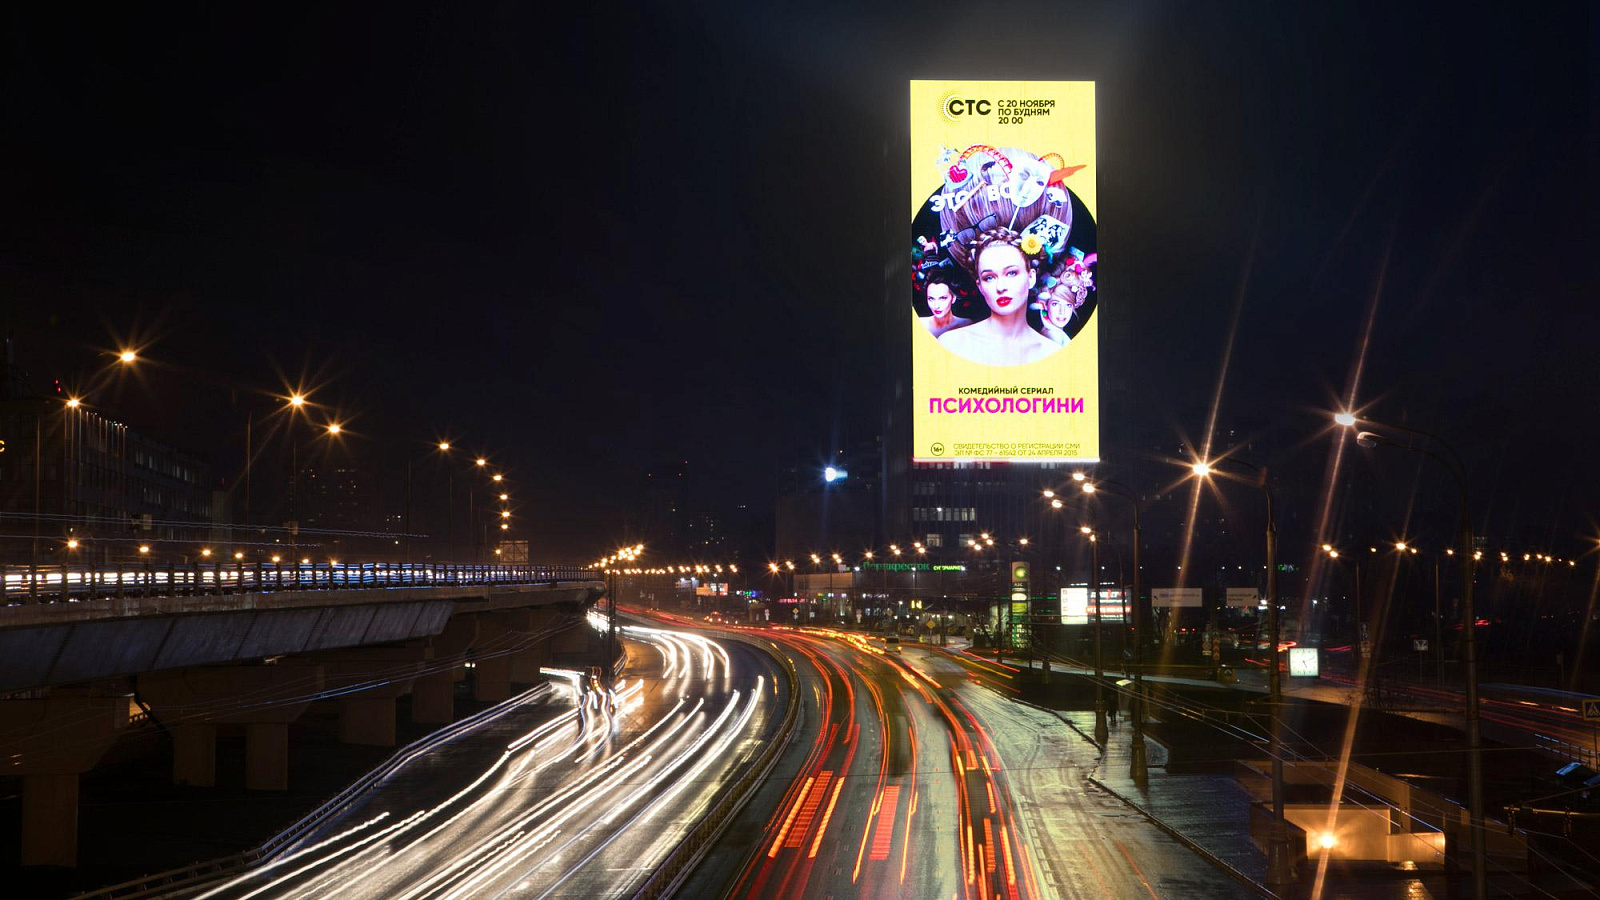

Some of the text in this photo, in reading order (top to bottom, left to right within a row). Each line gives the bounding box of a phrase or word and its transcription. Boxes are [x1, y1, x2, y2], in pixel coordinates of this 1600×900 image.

[949, 99, 991, 115] СТС
[1013, 109, 1050, 117] БУДНЯМ
[958, 386, 1018, 395] КОМЕДИЙНЫЙ
[929, 398, 1083, 413] ПСИХОЛОГИНИ
